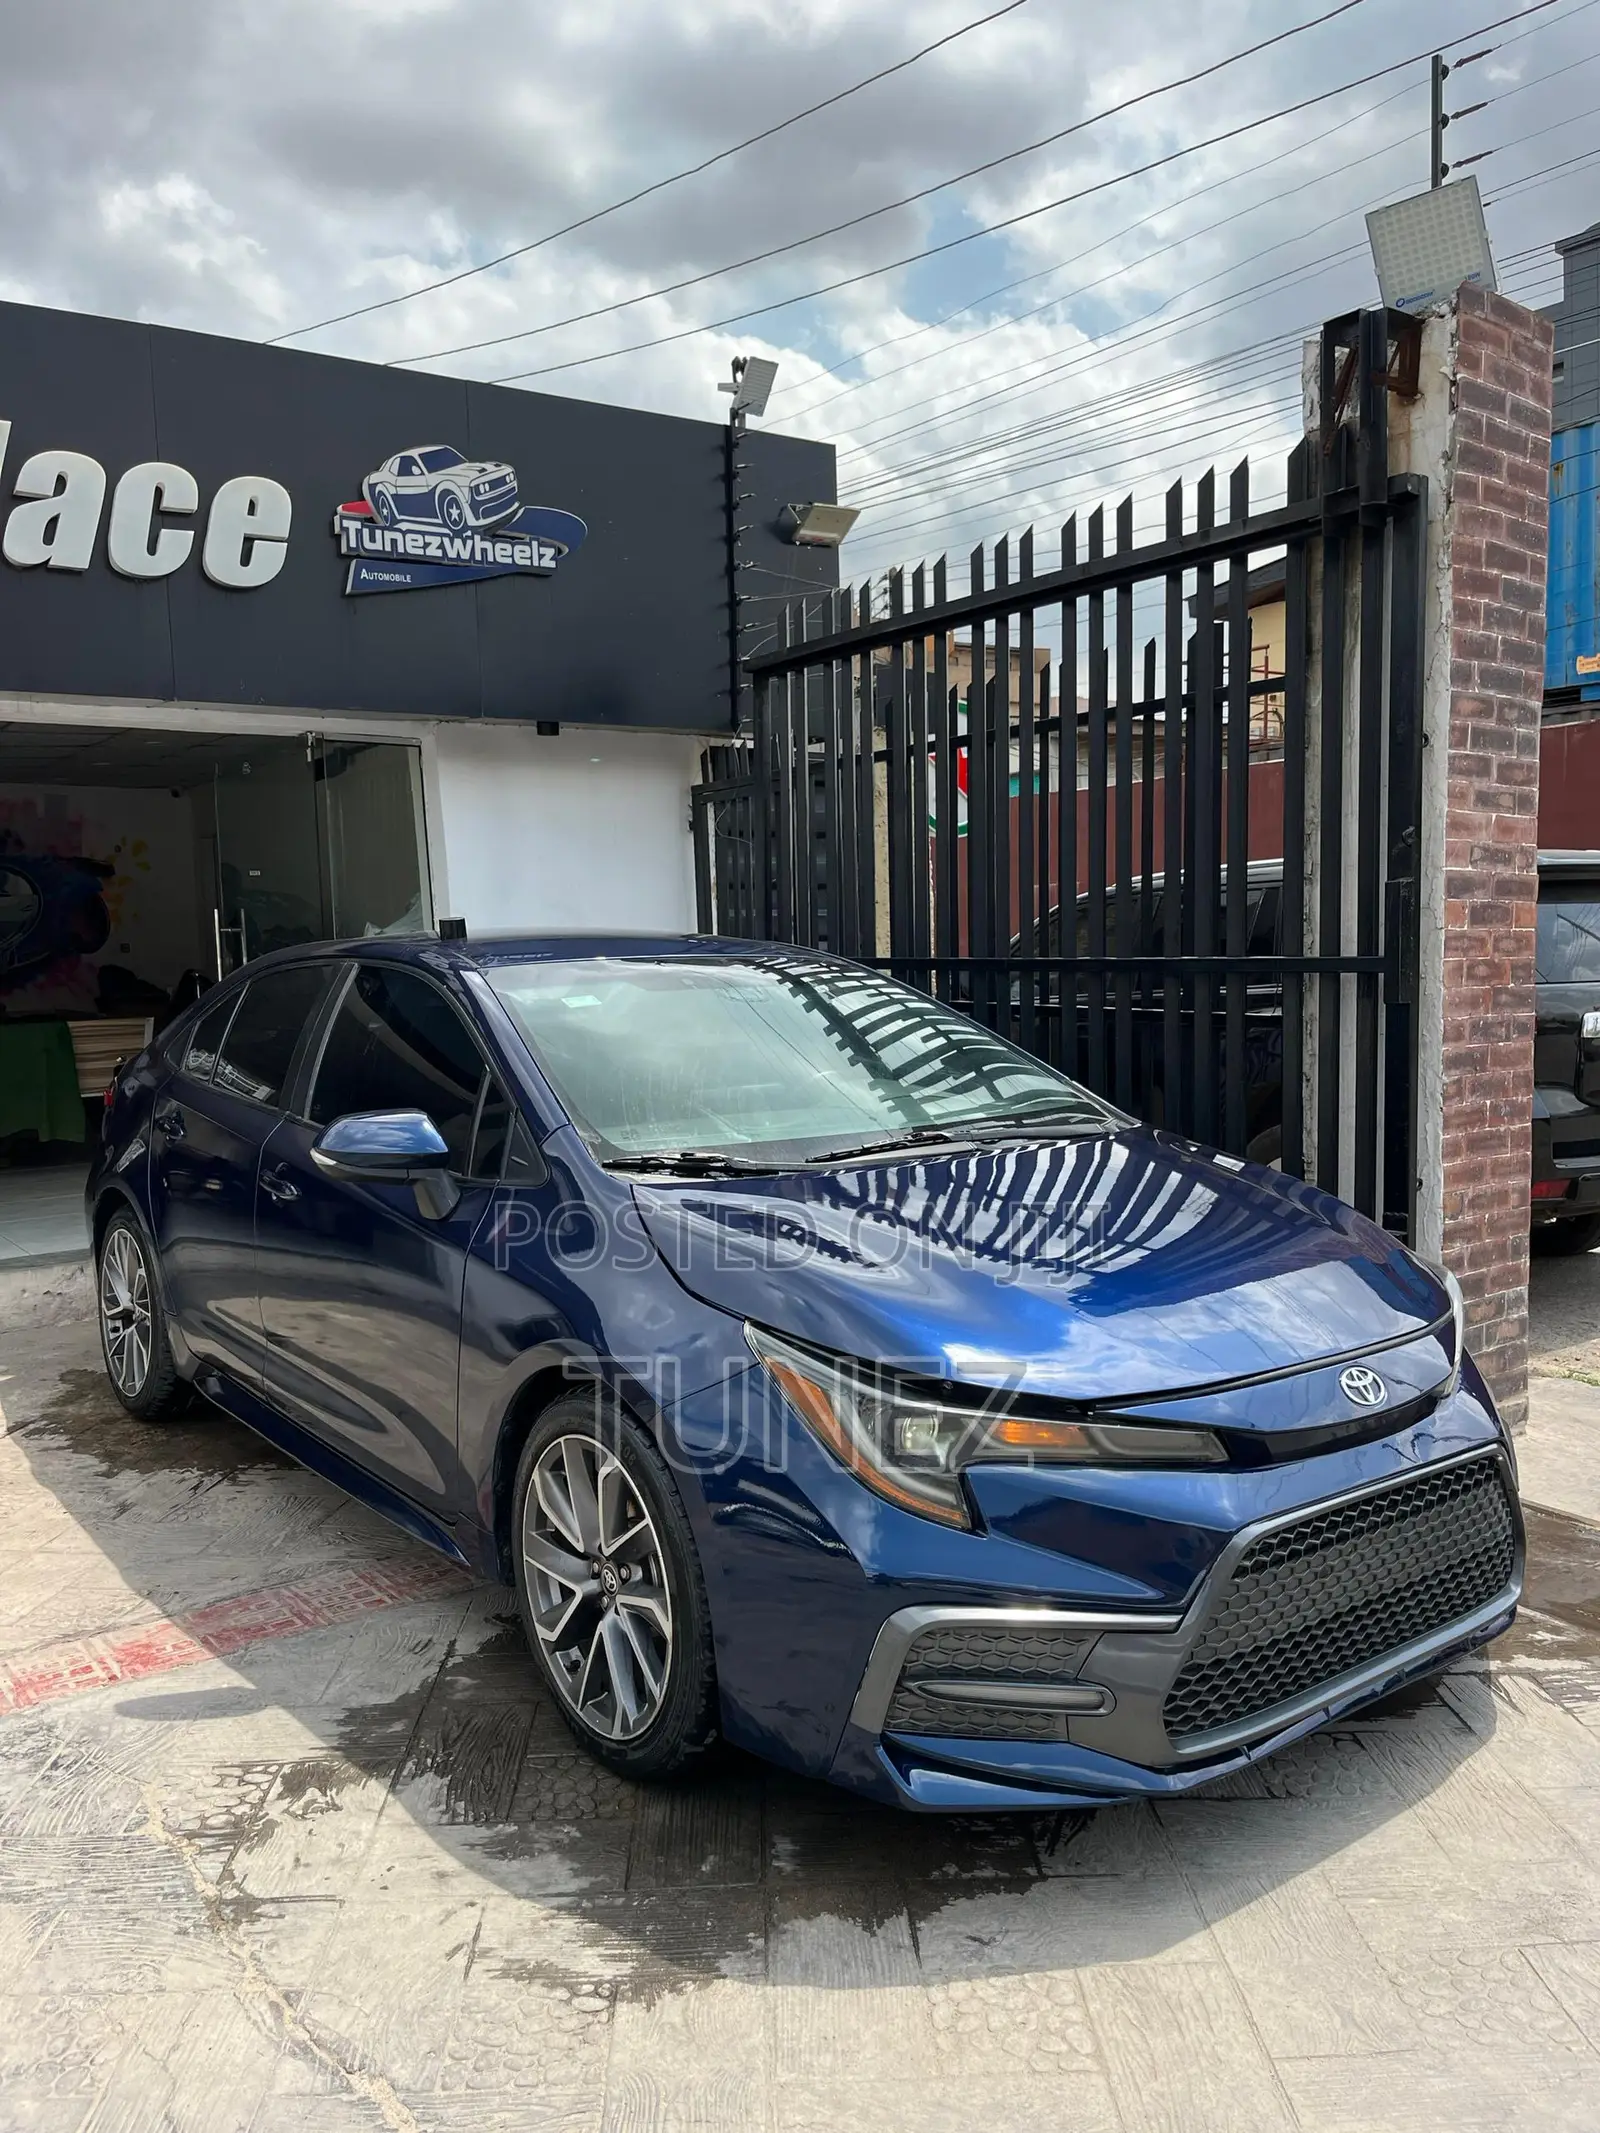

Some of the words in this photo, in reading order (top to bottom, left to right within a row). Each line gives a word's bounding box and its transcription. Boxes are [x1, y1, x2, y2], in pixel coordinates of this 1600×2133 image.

[0, 420, 292, 588] ace
[341, 518, 557, 568] Tunezwheelz
[360, 567, 412, 583] AUTOMOBILE
